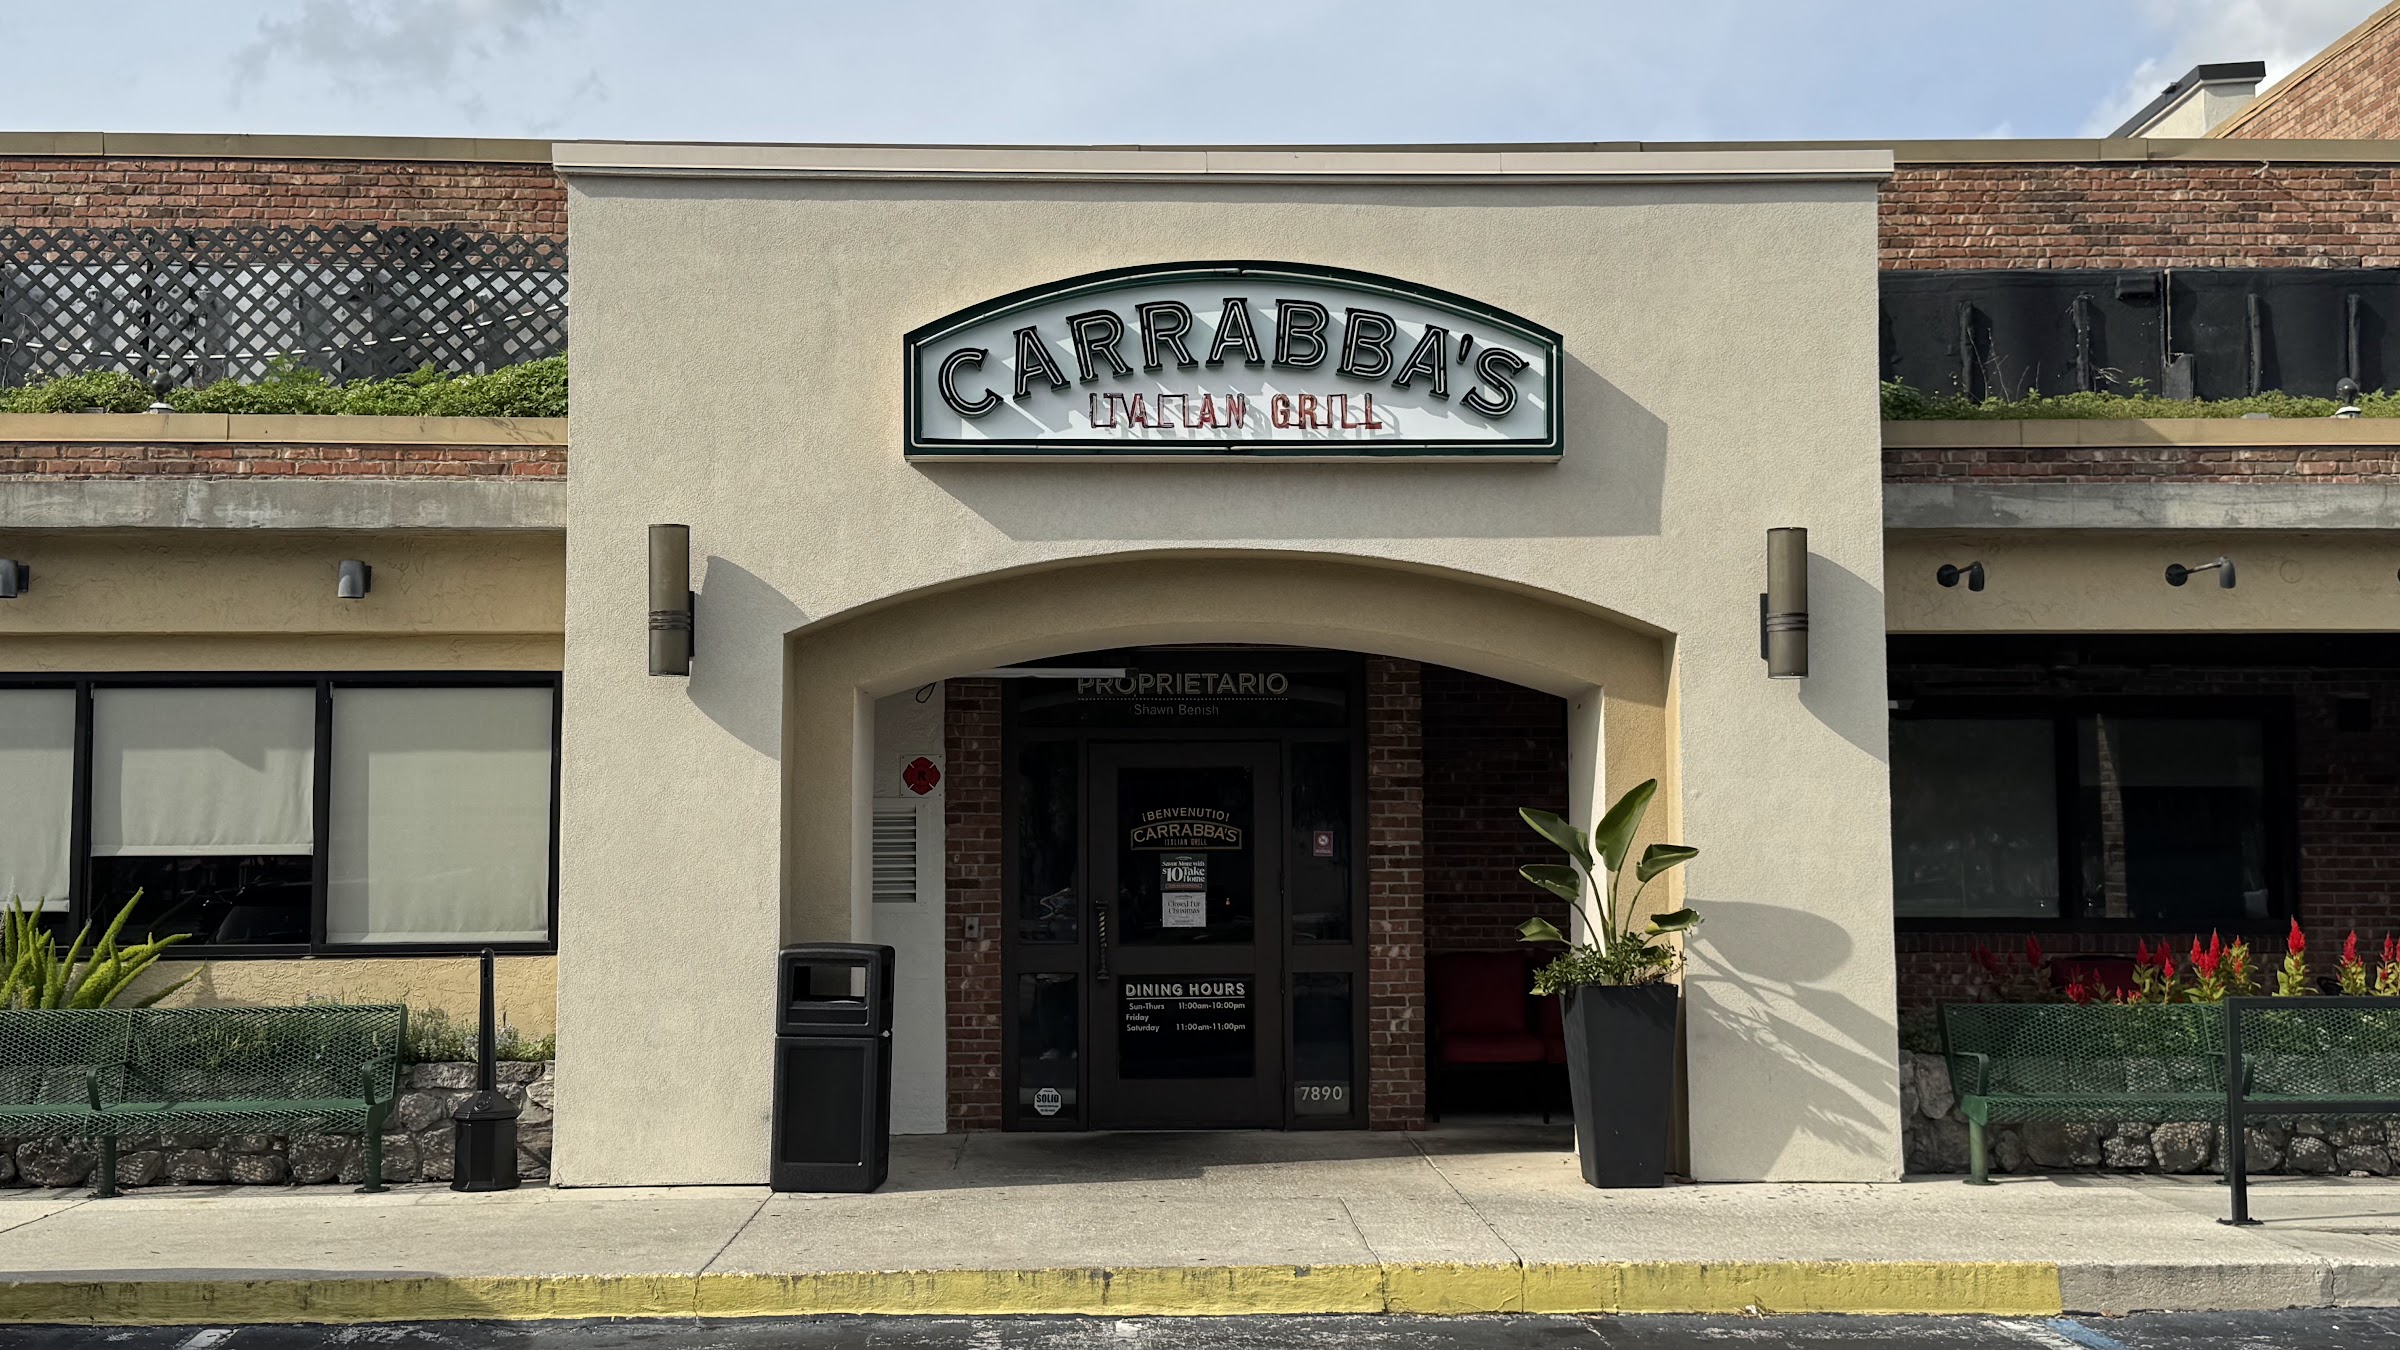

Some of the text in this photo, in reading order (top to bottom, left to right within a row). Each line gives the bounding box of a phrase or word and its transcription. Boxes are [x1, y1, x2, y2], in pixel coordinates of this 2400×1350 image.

[938, 297, 1530, 420] CARRABBA'S
[1089, 392, 1383, 430] ITALIAN GRILL
[1077, 673, 1289, 695] PROPRIETARIO
[1134, 703, 1219, 716] Shawn Benish
[1133, 823, 1238, 843] CARRABBA'S
[1164, 838, 1208, 846] ITALIAN GRILL
[1162, 867, 1206, 882] $10 Take
[1183, 875, 1206, 883] Home
[1168, 907, 1201, 915] Christmas
[1126, 982, 1246, 997] DINING HOURS
[1129, 1001, 1246, 1011] Sun-Thurs 11:00am-10:00pm
[1126, 1014, 1149, 1022] Friday
[1126, 1022, 1246, 1033] Saturday 11:00am-11:00pm
[1300, 1085, 1344, 1101] 7890
